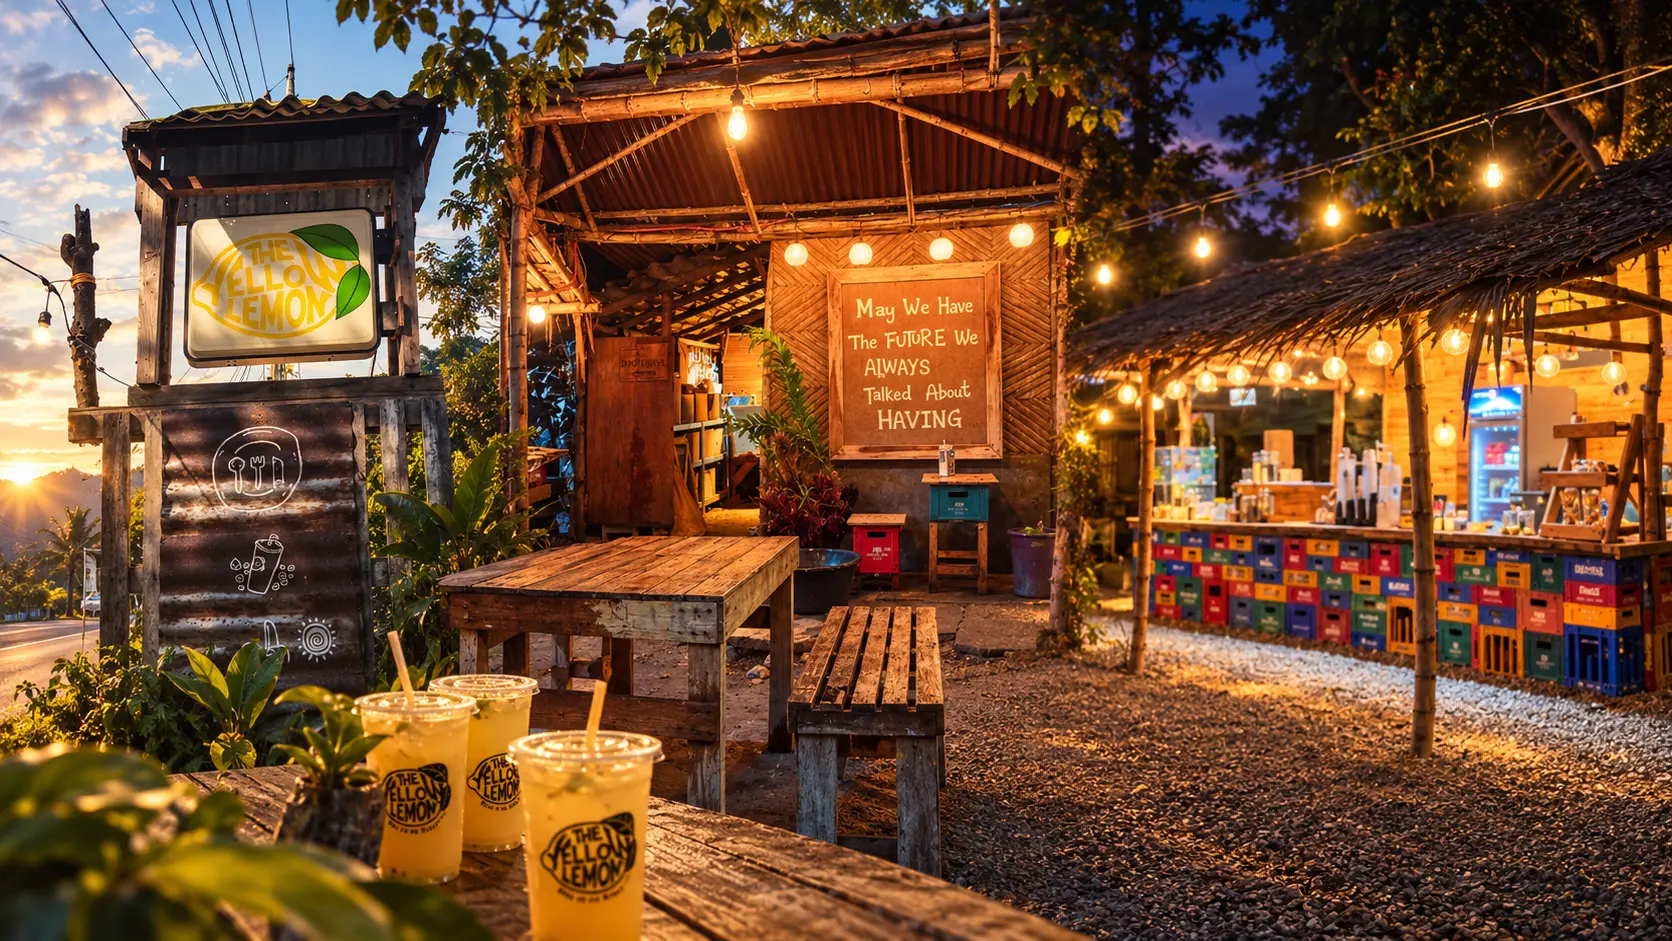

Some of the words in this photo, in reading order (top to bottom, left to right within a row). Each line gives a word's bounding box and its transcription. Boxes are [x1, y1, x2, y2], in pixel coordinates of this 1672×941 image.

[245, 240, 294, 265] THE
[200, 240, 347, 307] YELLOW
[225, 286, 335, 331] LEMON
[856, 298, 895, 324] May
[902, 297, 930, 315] We
[938, 296, 974, 315] Have
[848, 334, 877, 350] The
[884, 328, 946, 349] FUTURE
[954, 328, 979, 346] We
[864, 358, 931, 378] ALWAYS
[863, 384, 912, 405] Talked
[925, 380, 971, 401] About
[877, 408, 962, 430] HAVING
[396, 772, 421, 786] THE
[483, 779, 520, 802] LEMON
[390, 799, 438, 822] LEMON
[572, 826, 603, 844] THE
[547, 825, 630, 871] YELLOW
[561, 858, 623, 889] LEMON
